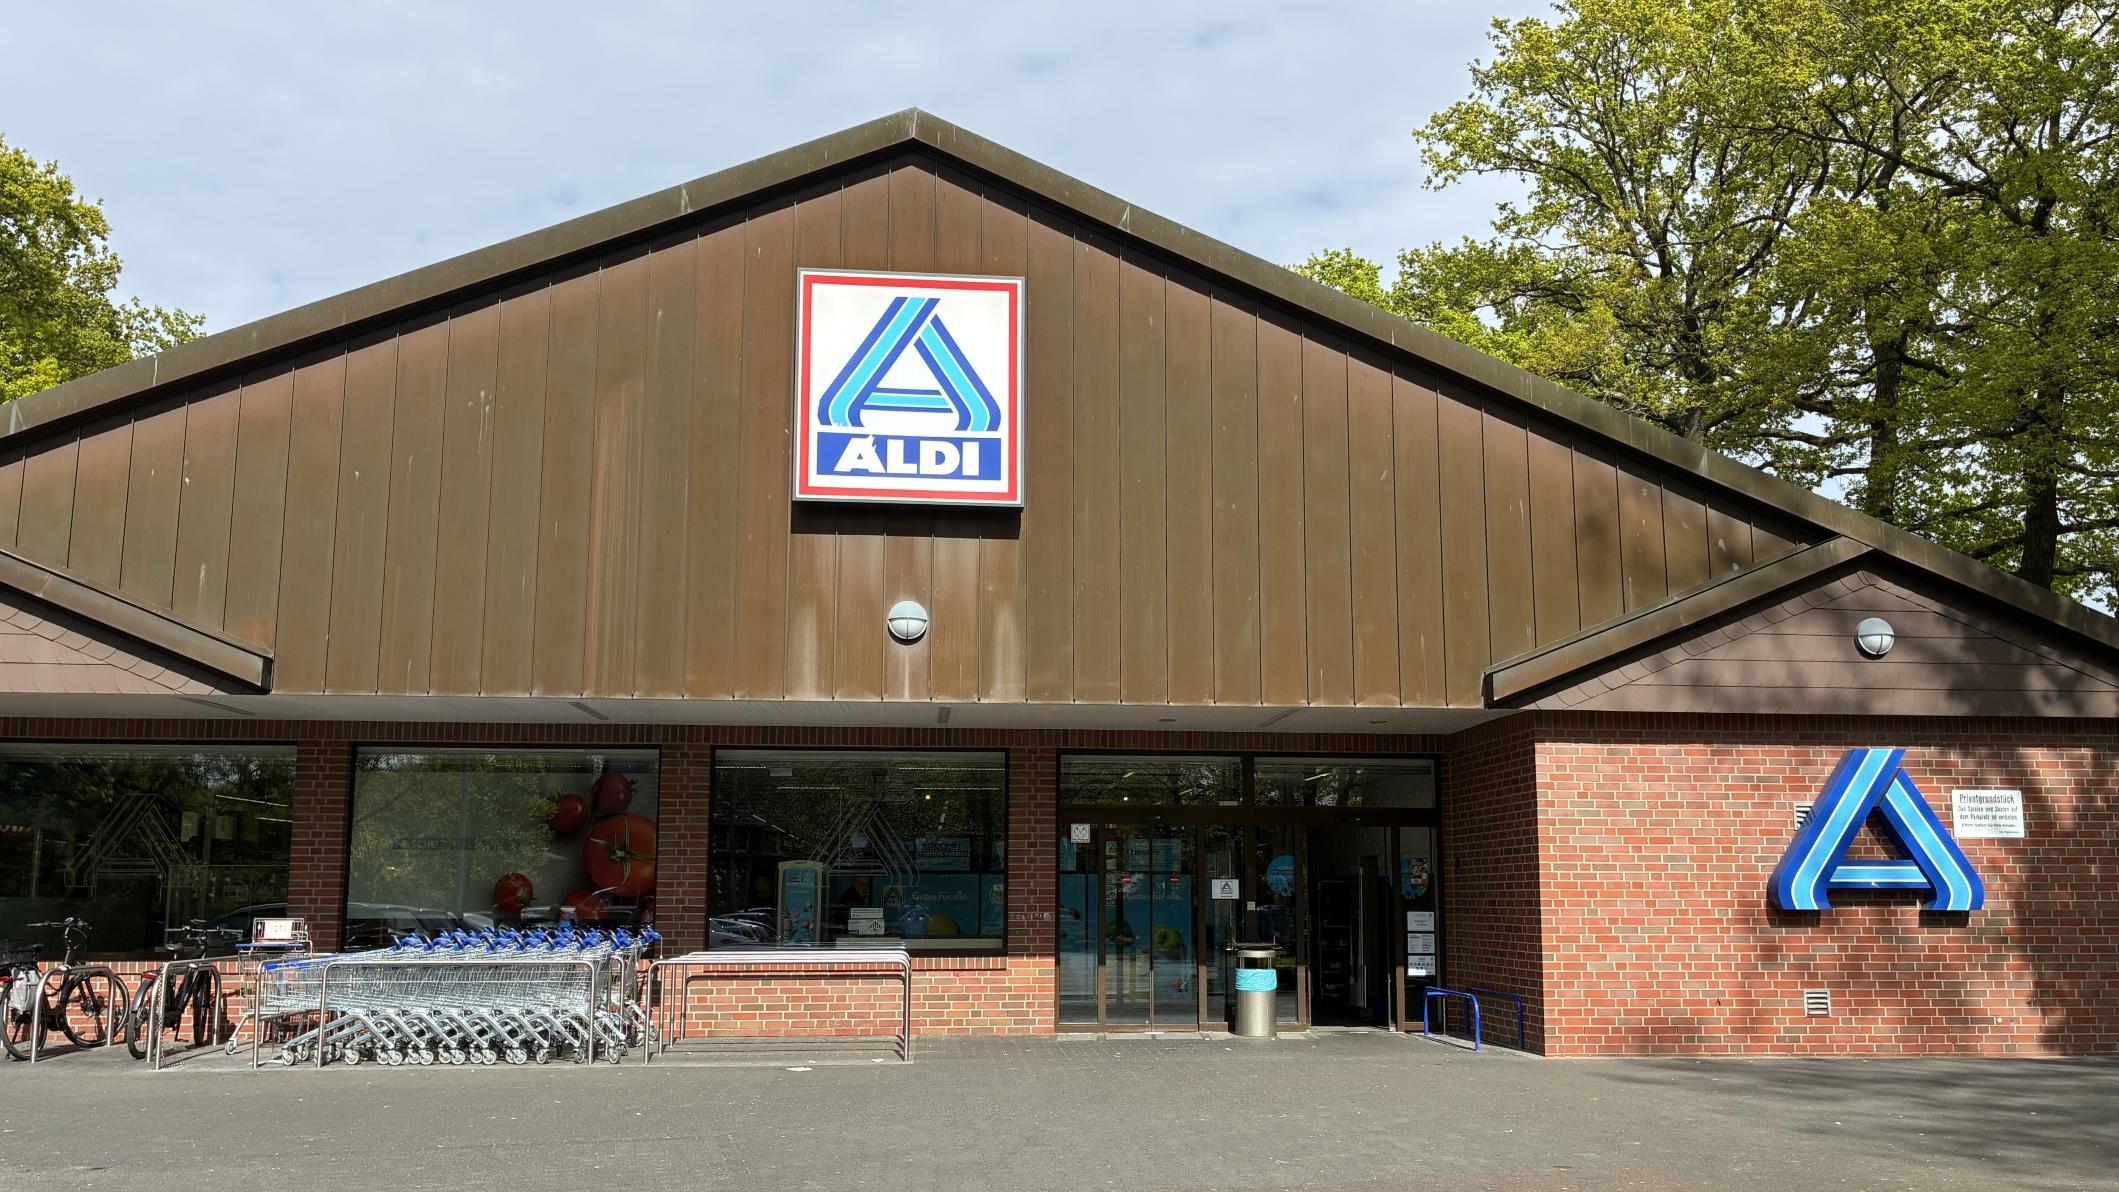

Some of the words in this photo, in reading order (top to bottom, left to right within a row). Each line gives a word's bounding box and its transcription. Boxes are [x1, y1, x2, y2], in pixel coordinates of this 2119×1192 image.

[834, 435, 980, 476] ALDI
[1959, 794, 2015, 804] Privatgrundstück
[911, 891, 937, 901] Gutes
